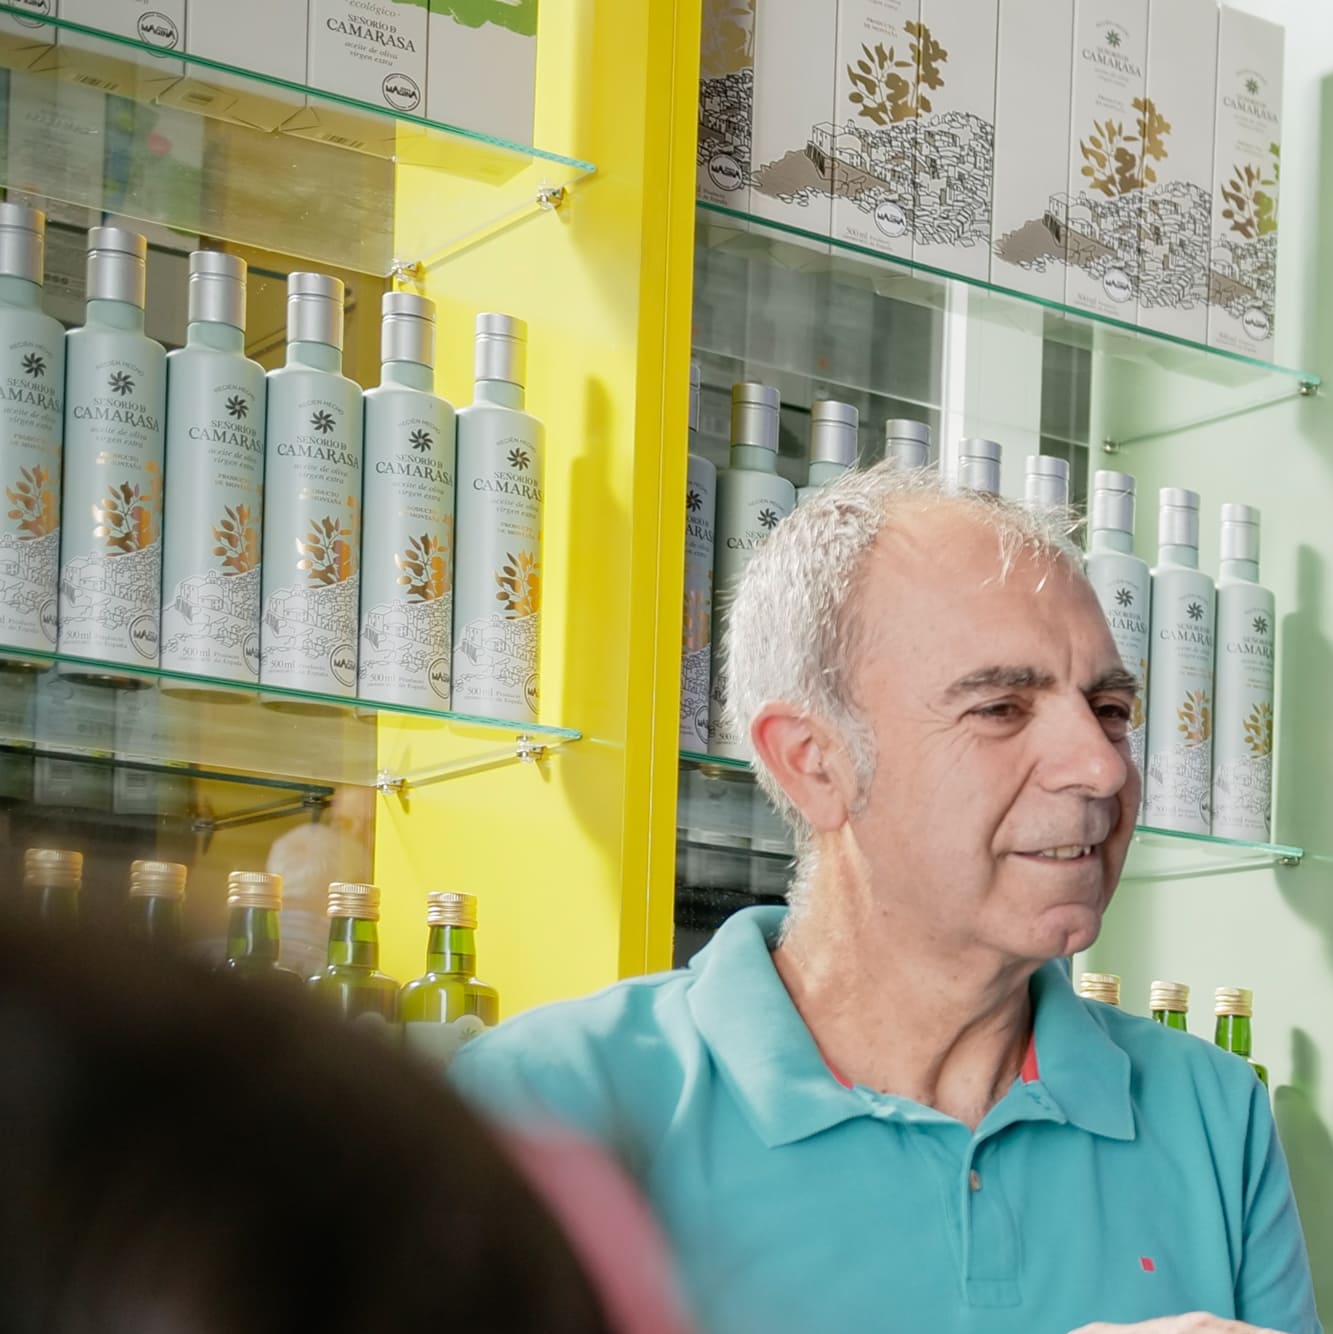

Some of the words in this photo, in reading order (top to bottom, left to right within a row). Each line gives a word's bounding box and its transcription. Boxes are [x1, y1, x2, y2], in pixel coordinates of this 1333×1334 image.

[326, 18, 416, 53] CAMARASA
[1082, 49, 1142, 78] CAMARASA
[1223, 96, 1279, 124] CAMARASA
[73, 406, 160, 432] CAMARASA
[188, 426, 264, 456] CAMARAS
[277, 443, 360, 469] CAMARASA
[473, 478, 545, 502] CAMARAS
[1160, 629, 1213, 647] CAMARA
